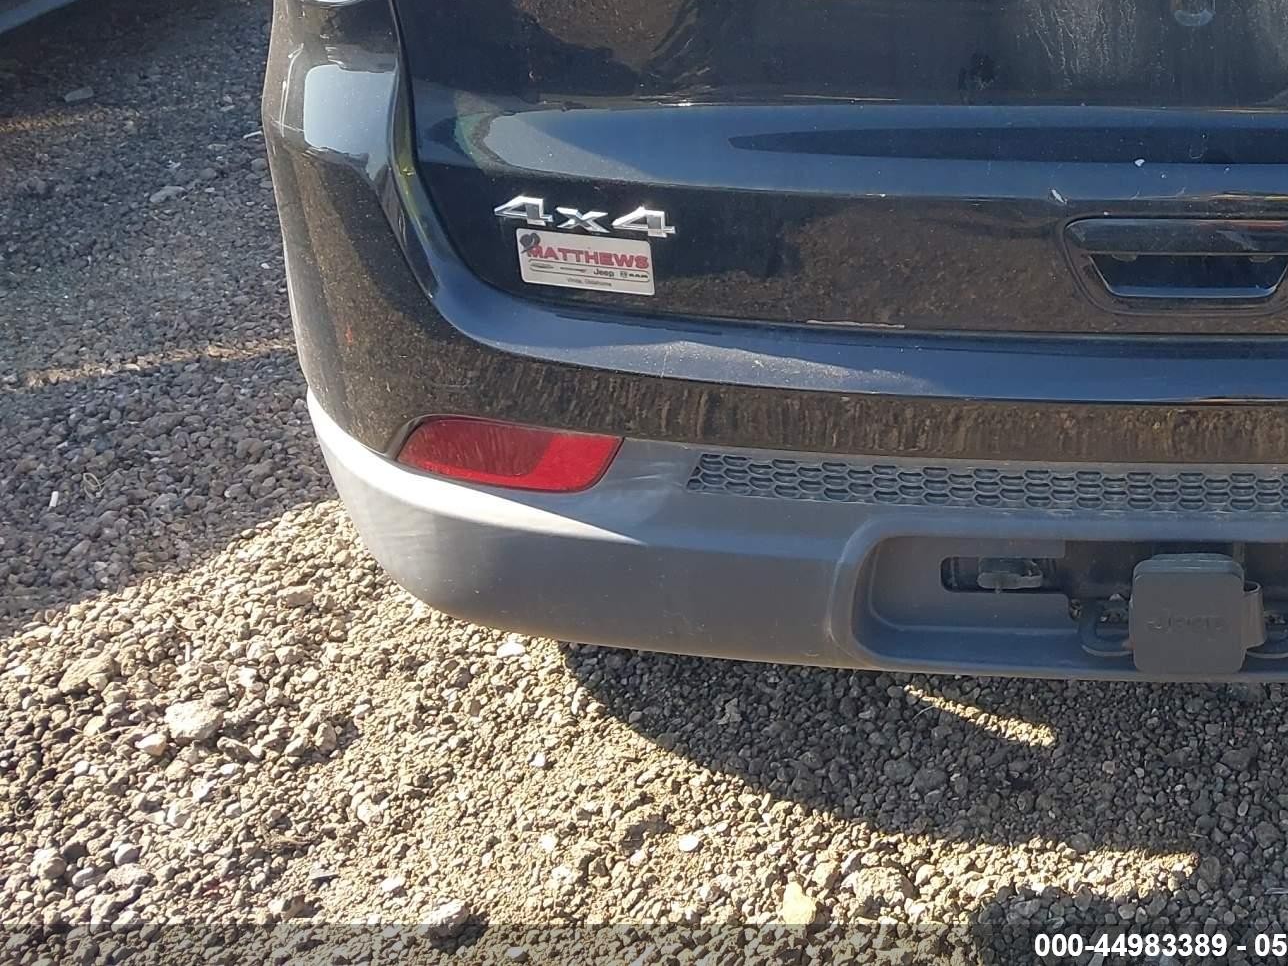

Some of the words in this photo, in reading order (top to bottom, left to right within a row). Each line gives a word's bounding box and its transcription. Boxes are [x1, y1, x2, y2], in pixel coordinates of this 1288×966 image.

[493, 194, 677, 238] 4x4
[527, 244, 650, 270] MATTHEWS
[593, 268, 615, 278] Jeep
